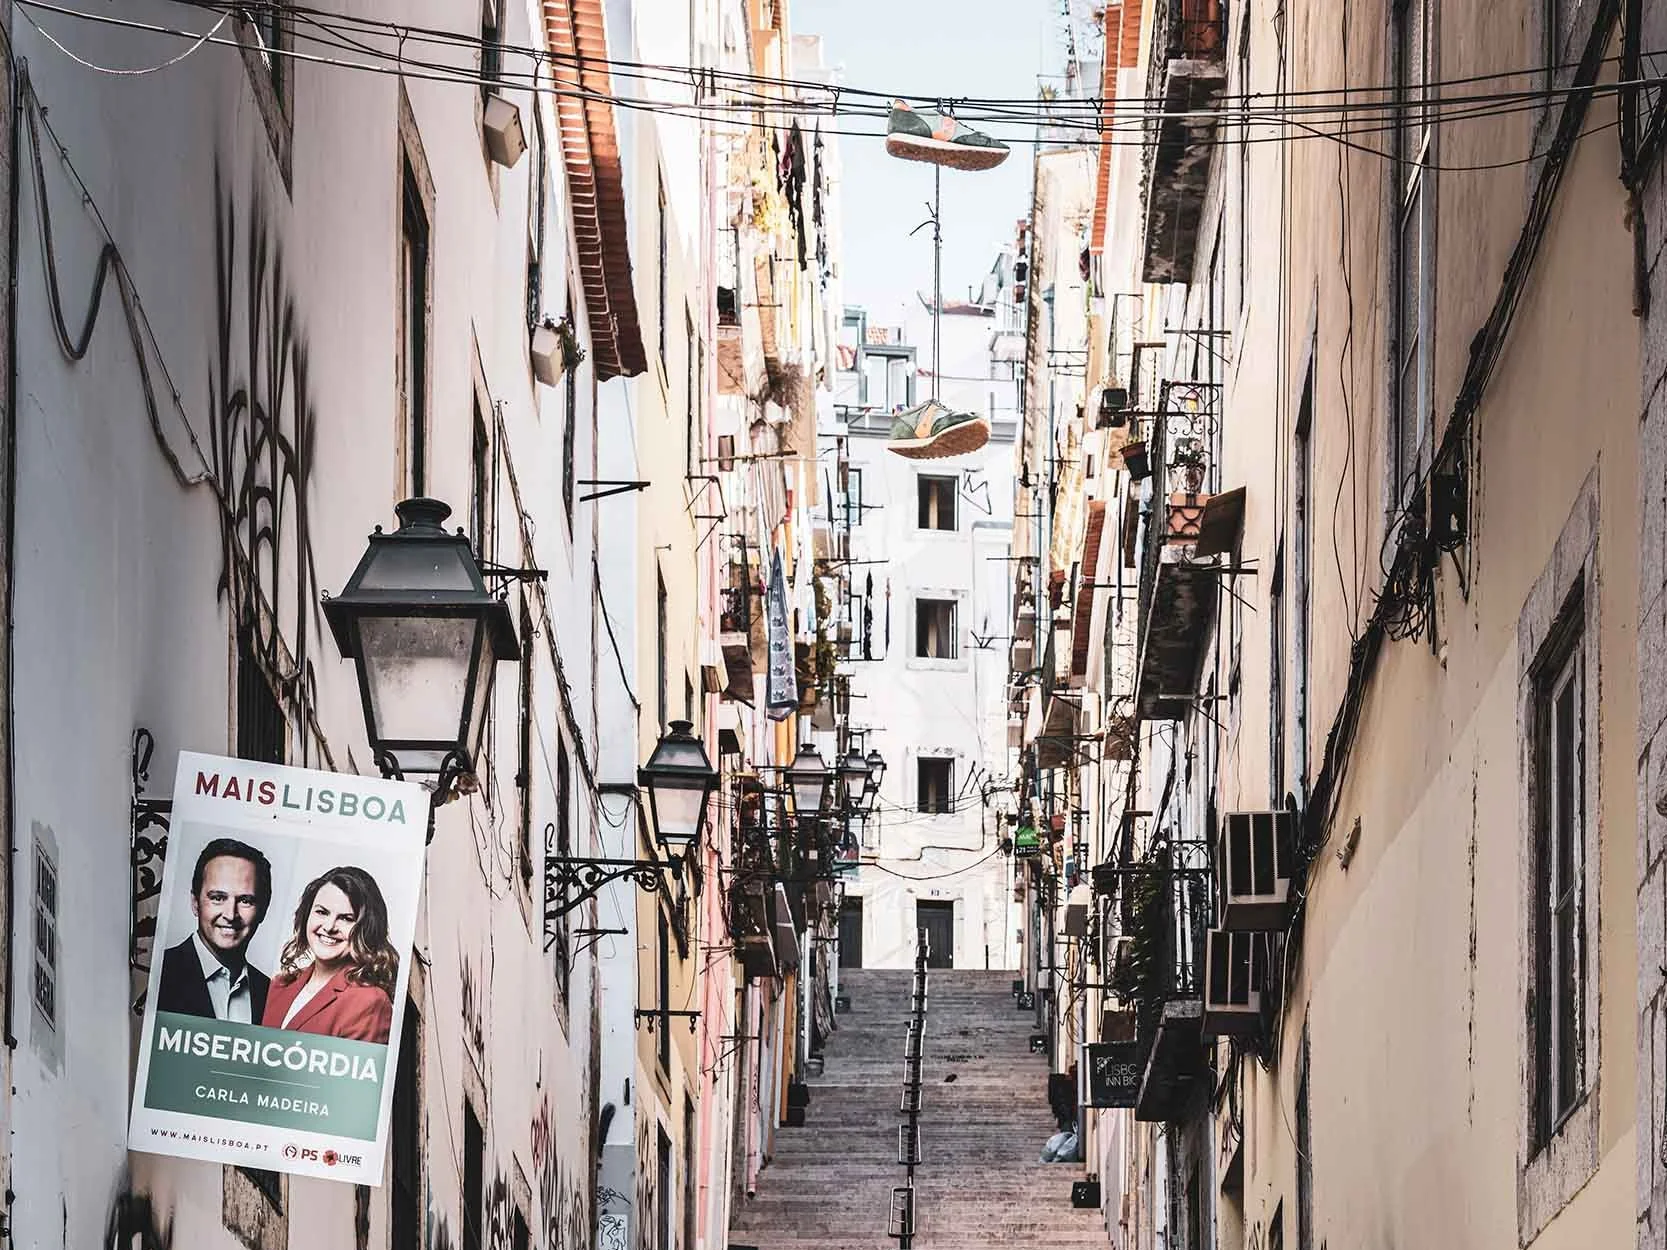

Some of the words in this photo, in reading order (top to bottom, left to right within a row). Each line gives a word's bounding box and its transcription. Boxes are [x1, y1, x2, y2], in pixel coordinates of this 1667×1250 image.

[158, 1027, 379, 1083] MISERICÓRDIA
[195, 1085, 249, 1105] CARLA
[257, 1094, 329, 1117] MADEIRA
[151, 1128, 270, 1152] WWW.MAISLISBOA.PT
[301, 1148, 319, 1161] PS
[338, 1153, 362, 1166] LIVRE
